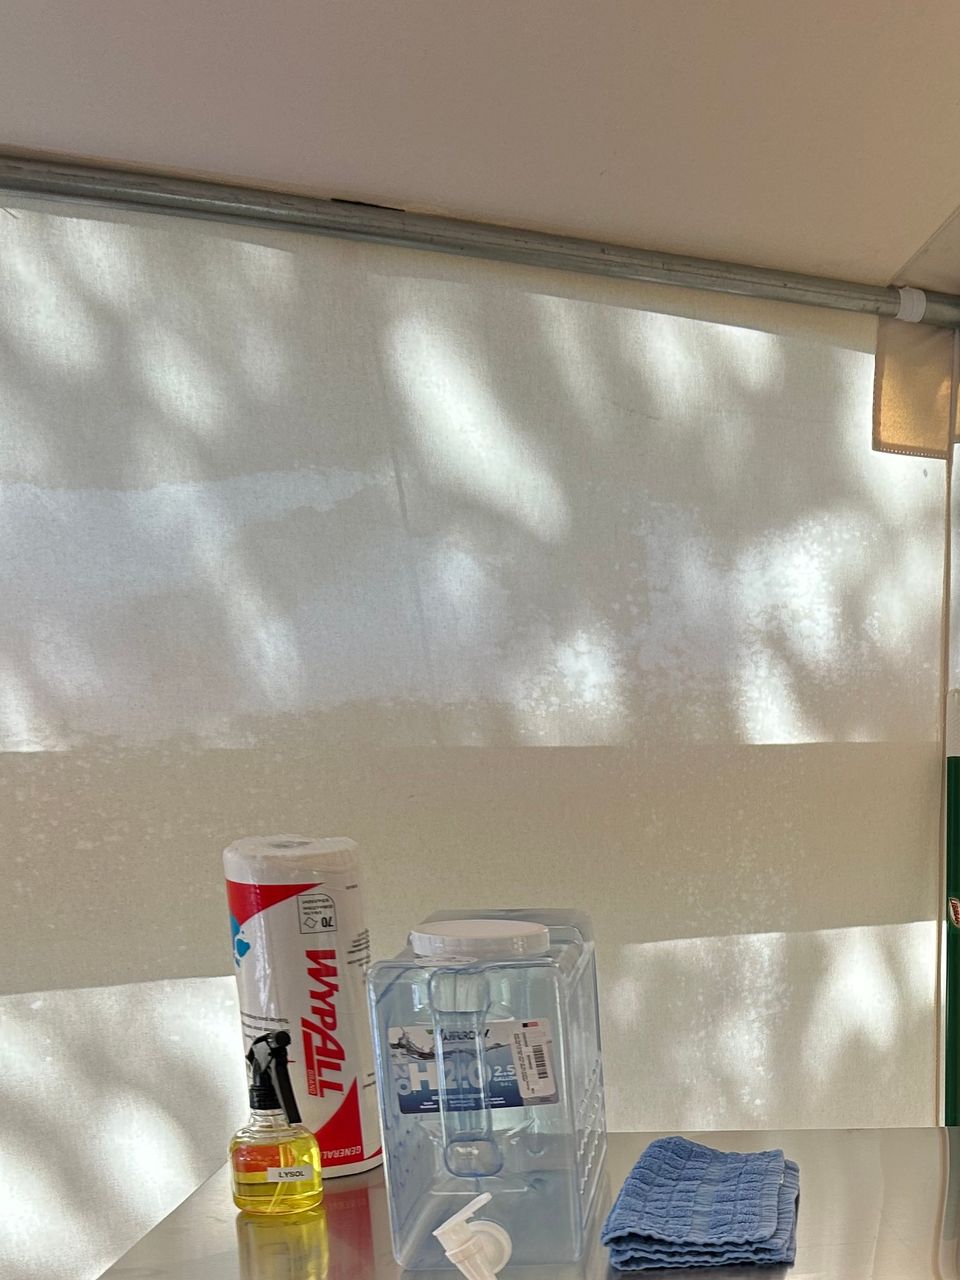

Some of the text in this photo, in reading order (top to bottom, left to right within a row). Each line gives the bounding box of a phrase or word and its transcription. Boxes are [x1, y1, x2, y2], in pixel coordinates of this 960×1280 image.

[321, 916, 334, 928] 70
[493, 1065, 516, 1077] 2.5
[322, 1145, 362, 1159] GENERAL
[278, 1170, 305, 1178] LYSOL
